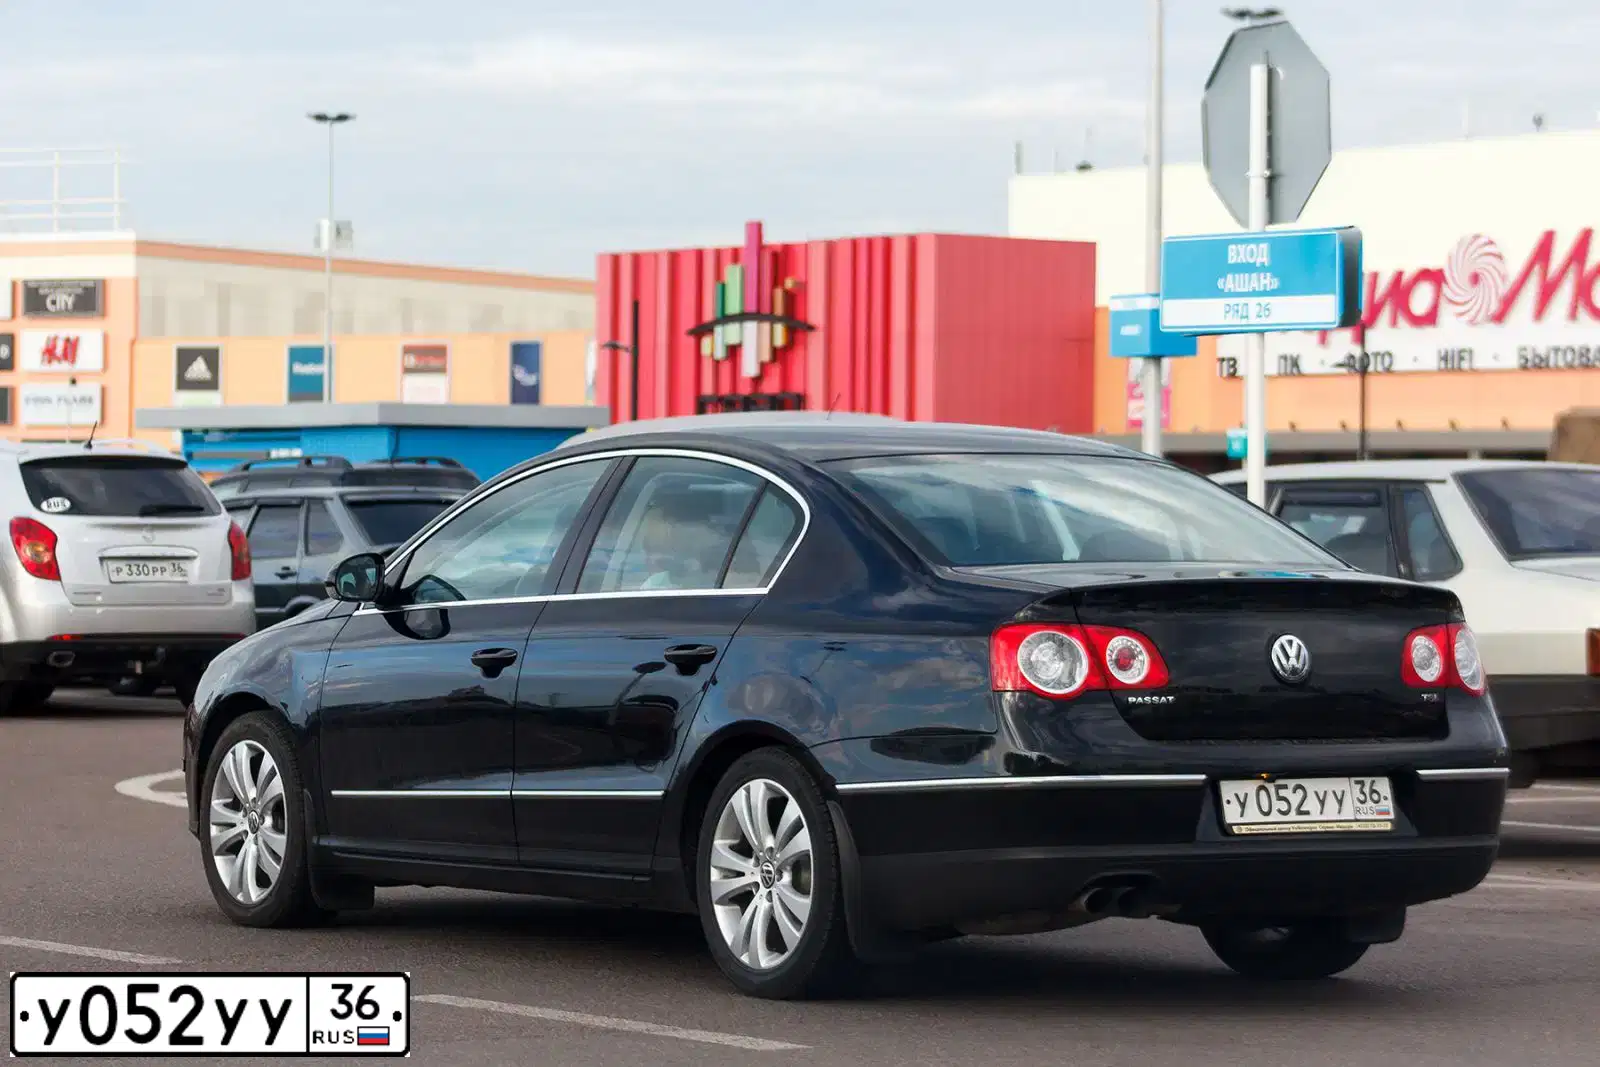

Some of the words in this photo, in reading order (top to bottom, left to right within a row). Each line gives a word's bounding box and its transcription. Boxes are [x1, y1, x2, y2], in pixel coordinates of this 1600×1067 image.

[1227, 243, 1269, 268] ВХОД
[1217, 272, 1279, 292] «АШАН»
[1224, 302, 1249, 320] РЯД
[1255, 302, 1271, 319] 26
[1217, 357, 1238, 377] ТВ
[1277, 353, 1302, 376] ПК
[1127, 696, 1176, 704] PASSAT
[1354, 779, 1382, 805] 36
[1355, 806, 1376, 816] RUS
